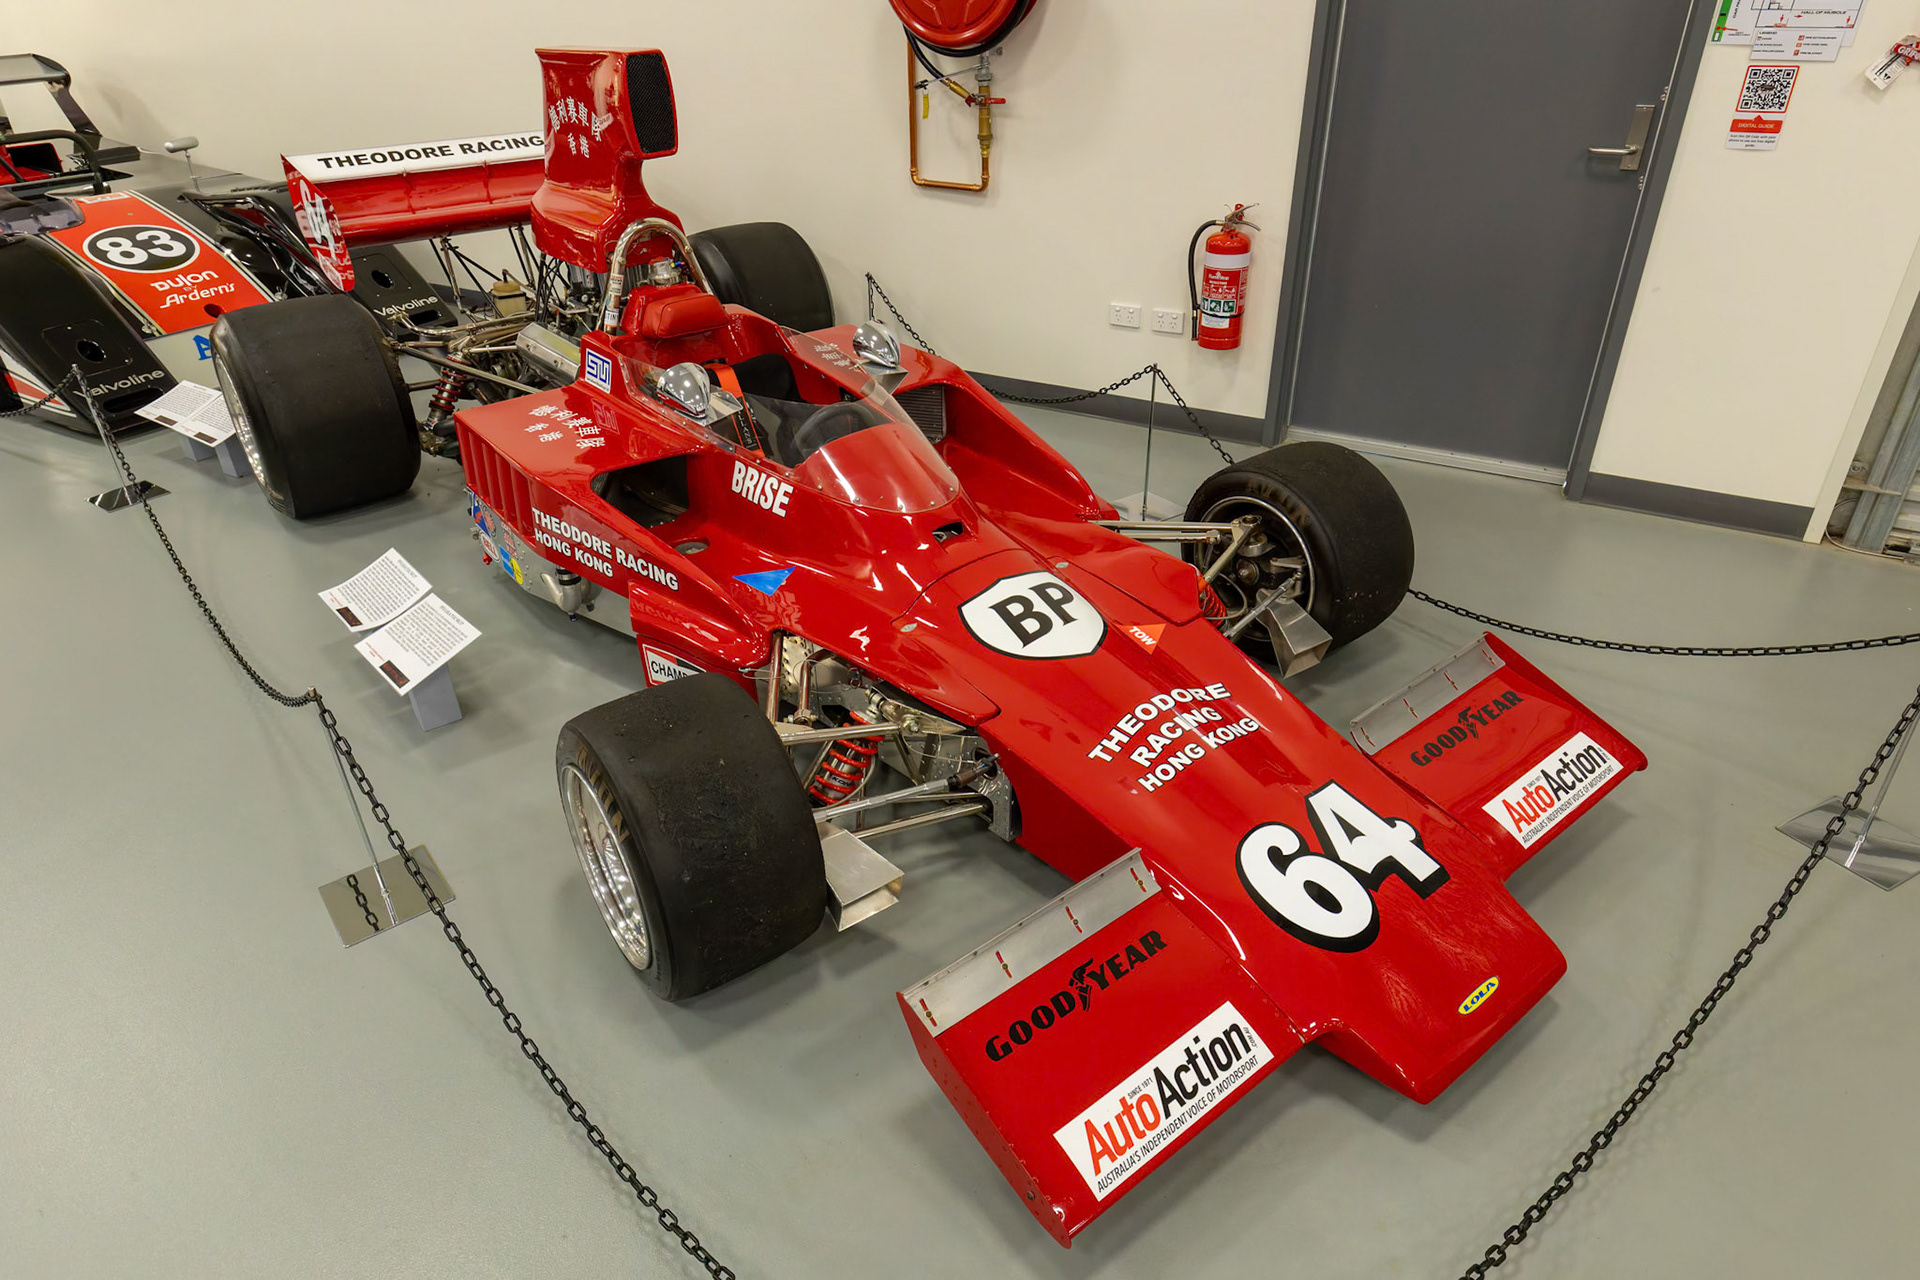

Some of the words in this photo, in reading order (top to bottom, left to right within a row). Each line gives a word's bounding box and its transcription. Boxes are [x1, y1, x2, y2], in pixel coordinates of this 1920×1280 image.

[318, 145, 454, 169] THEODORE
[458, 135, 545, 155] RACING
[96, 230, 187, 265] 83
[300, 179, 336, 261] 64
[160, 283, 235, 309] Ardern's
[373, 295, 439, 317] Valvoline
[731, 460, 794, 518] BRISE
[532, 507, 613, 560] THEODORE
[615, 546, 679, 591] RACING
[534, 527, 572, 557] HONG
[574, 547, 614, 578] KONG
[988, 581, 1078, 649] BP
[1129, 625, 1156, 646] TOW
[1087, 682, 1232, 762] THEODORE
[1129, 706, 1223, 768] RACING
[1137, 742, 1207, 793] HONG
[1201, 717, 1260, 750] KONG
[1522, 820, 1548, 843] AUSTRALIA'S
[1547, 799, 1574, 824] INDEPENDENT
[1573, 789, 1585, 803] VOICE
[1583, 785, 1590, 794] OF
[1588, 765, 1614, 789] MOTORSPORT
[1237, 780, 1447, 947] 64
[1463, 982, 1497, 1012] LOLA
[1127, 1085, 1143, 1099] SINCE
[1141, 1077, 1154, 1089] 1971
[1098, 1150, 1142, 1192] AUSTRALIA'S
[1140, 1112, 1188, 1158] INDEPENDENT
[1186, 1096, 1208, 1119] VOICE
[1206, 1088, 1217, 1102] OF
[1215, 1055, 1259, 1096] MOTORSPORT
